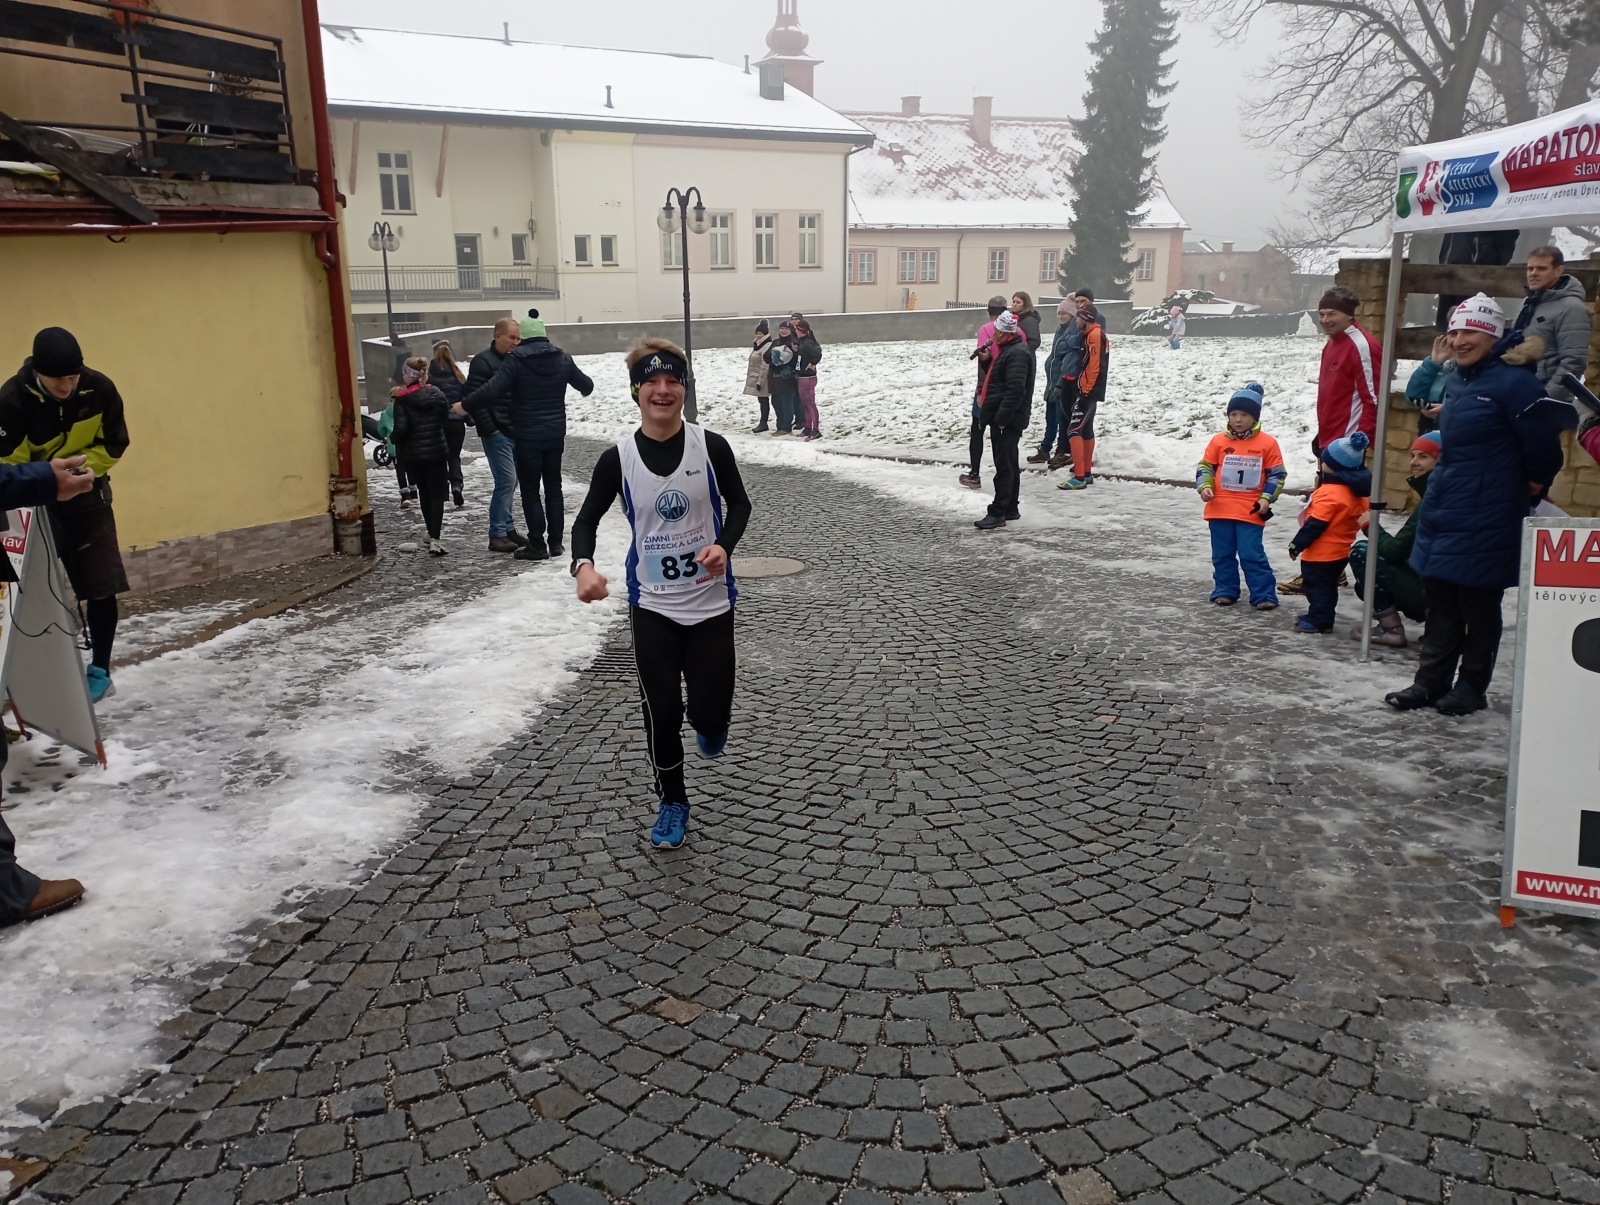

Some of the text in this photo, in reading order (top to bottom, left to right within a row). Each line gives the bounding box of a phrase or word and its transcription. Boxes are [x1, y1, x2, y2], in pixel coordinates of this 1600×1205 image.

[1450, 159, 1478, 176] ČESKÝ
[1448, 171, 1492, 192] ATLETICKÝ
[1454, 192, 1475, 207] SVAZ
[1237, 470, 1245, 485] 1
[644, 533, 670, 543] ZIMNÍ
[687, 534, 706, 545] LIGA
[661, 551, 698, 580] 83
[1535, 590, 1600, 605] tělovýc
